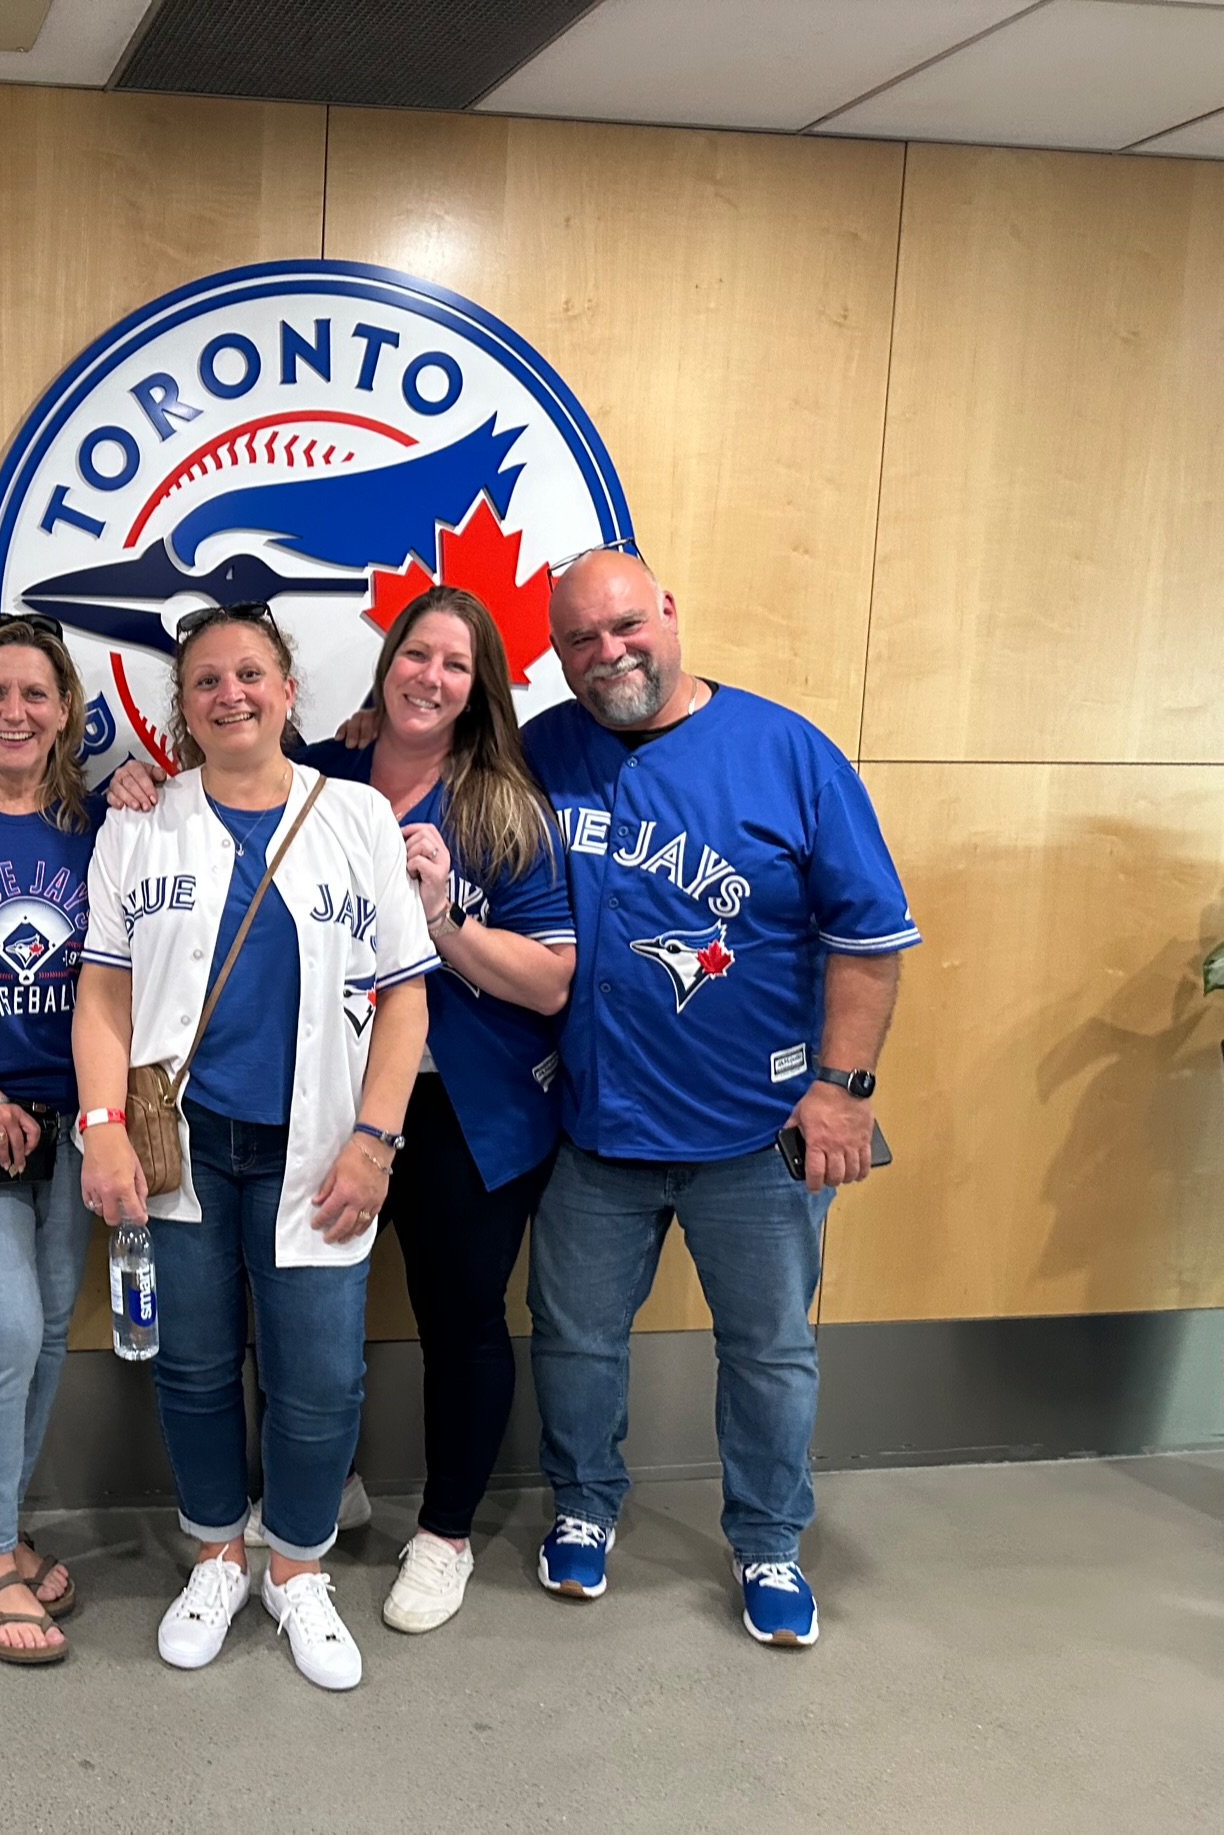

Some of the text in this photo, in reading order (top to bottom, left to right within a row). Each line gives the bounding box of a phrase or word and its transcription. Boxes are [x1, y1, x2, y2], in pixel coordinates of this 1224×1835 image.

[39, 318, 463, 541] TORONTO
[612, 821, 751, 918] JAYS
[137, 1264, 153, 1320] smart
